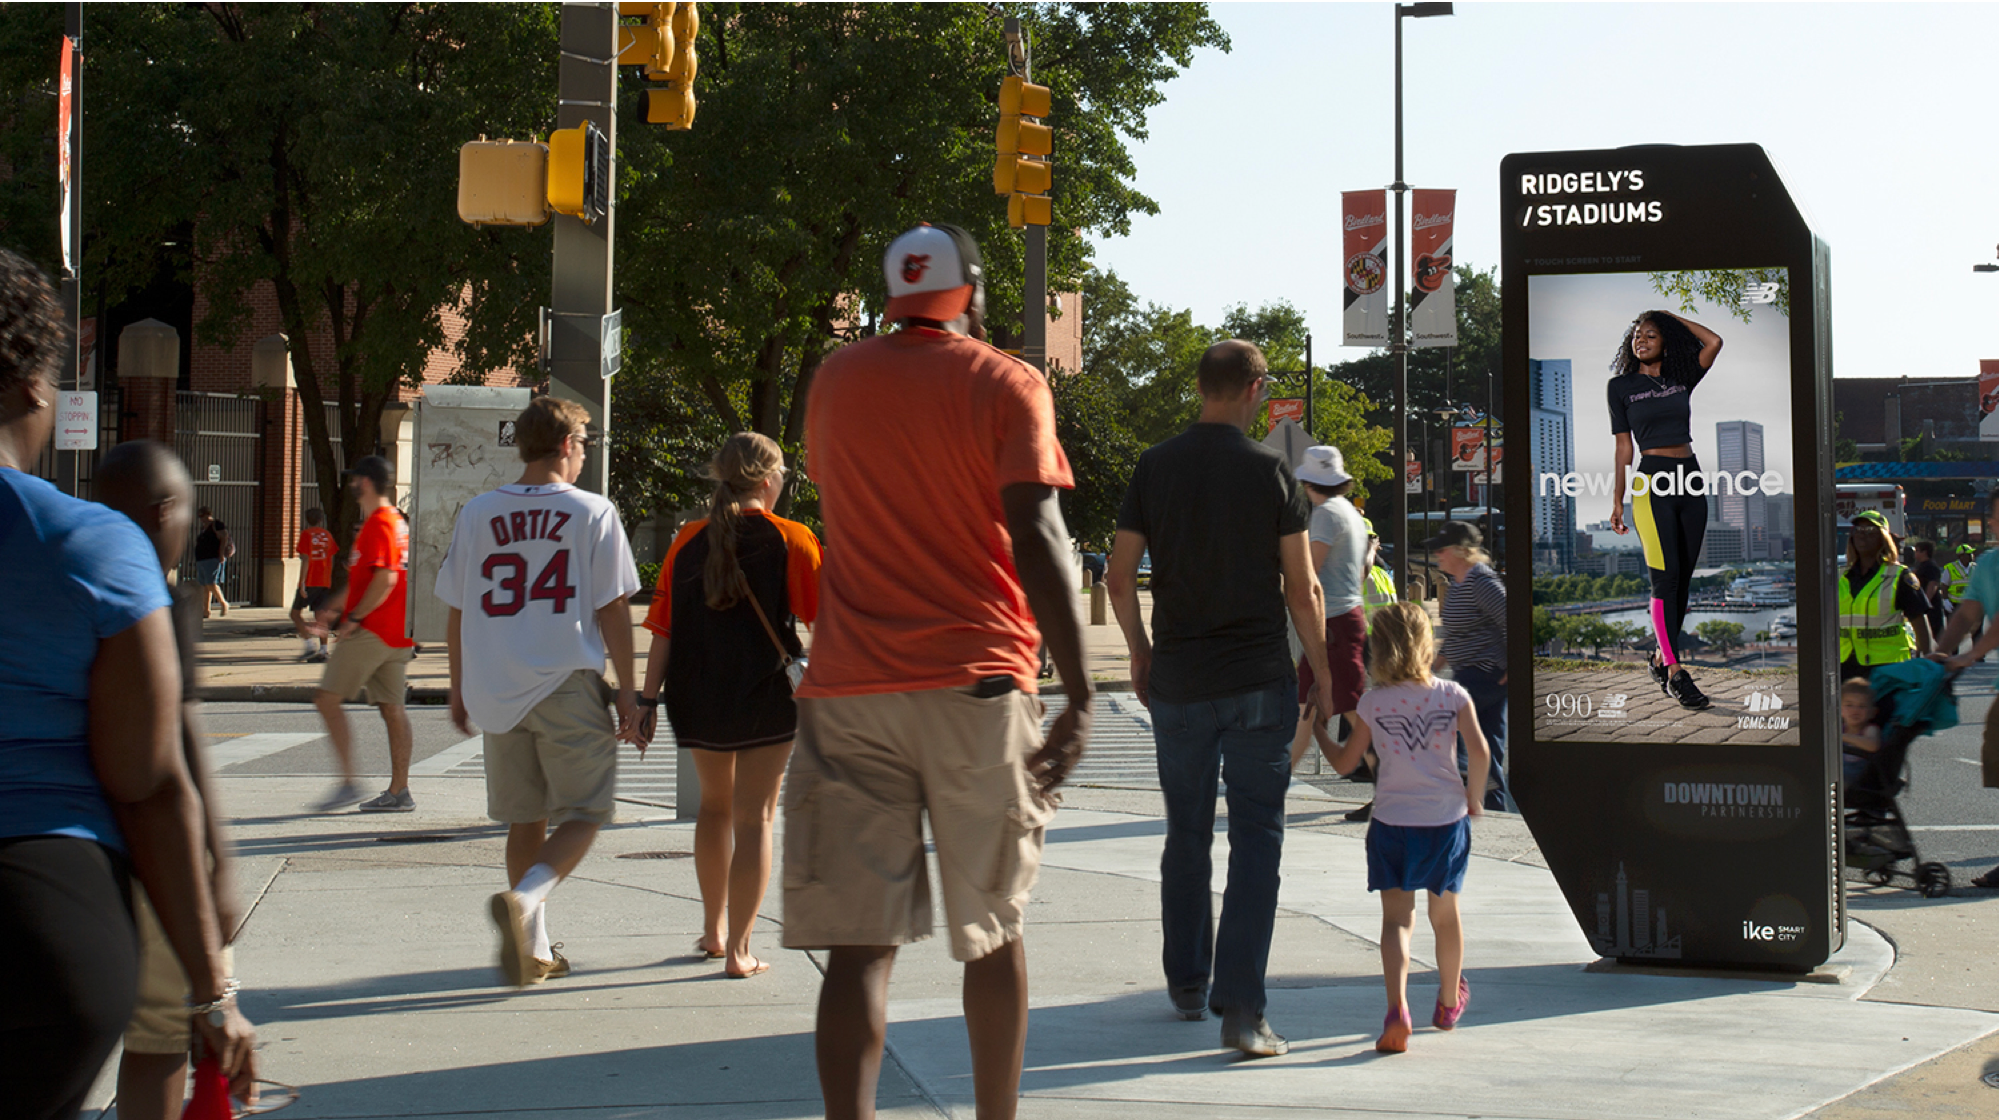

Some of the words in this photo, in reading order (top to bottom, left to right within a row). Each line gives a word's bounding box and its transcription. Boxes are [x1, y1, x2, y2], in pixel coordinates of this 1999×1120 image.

[1521, 169, 1644, 195] RIDGELY'S
[1534, 258, 1564, 266] TOUCH
[1566, 257, 1599, 265] SCREEN
[1601, 256, 1613, 264] TO
[1615, 255, 1642, 263] START
[70, 396, 84, 407] NO
[1540, 471, 1615, 497] new
[1625, 464, 1785, 498] balance
[490, 508, 572, 546] ORTIZ
[480, 549, 576, 617] 34
[1546, 693, 1592, 718] 990
[1738, 716, 1790, 730] YCMC.COM
[1664, 782, 1783, 806] DOWNTOWN
[1702, 805, 1801, 819] PARTNERSHIP
[1743, 920, 1775, 941] ike
[1778, 926, 1805, 934] SMART
[1778, 934, 1796, 942] CITY
